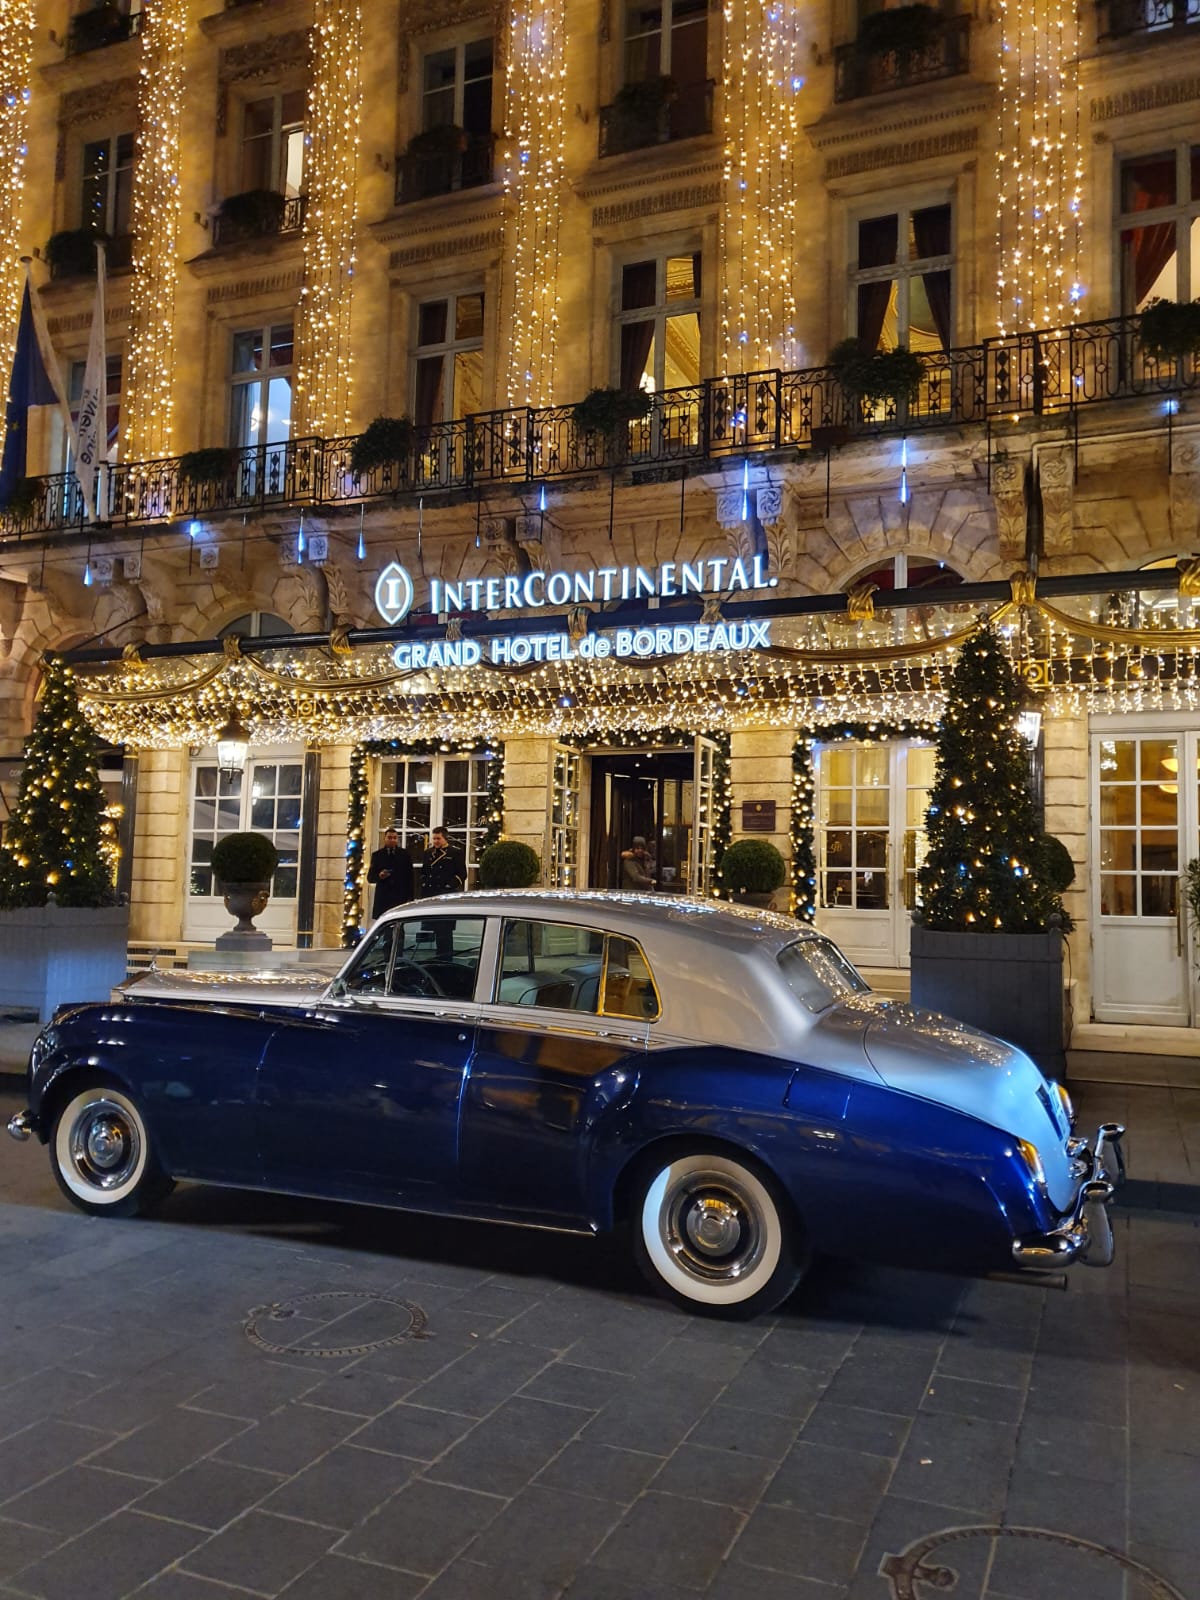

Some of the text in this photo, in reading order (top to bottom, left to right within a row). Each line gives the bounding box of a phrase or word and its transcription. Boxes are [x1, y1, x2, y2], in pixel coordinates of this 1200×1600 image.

[393, 621, 771, 670] GRAND HOTEL de BORDEAUX
